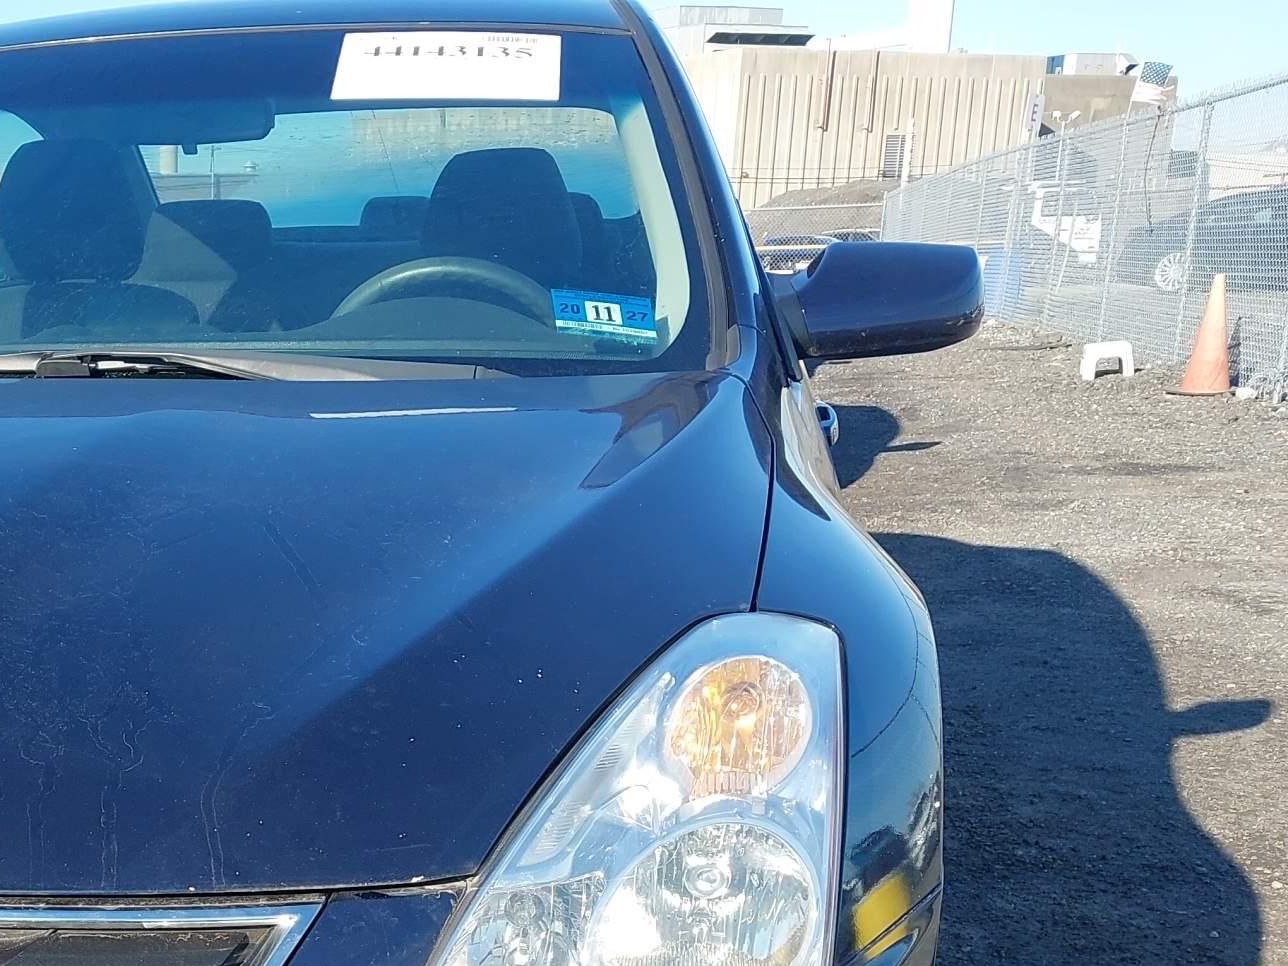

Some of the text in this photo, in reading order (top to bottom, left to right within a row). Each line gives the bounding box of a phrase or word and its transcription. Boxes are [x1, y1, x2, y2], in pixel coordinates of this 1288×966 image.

[363, 45, 534, 59] 44143135
[559, 302, 649, 322] 20 11 27
